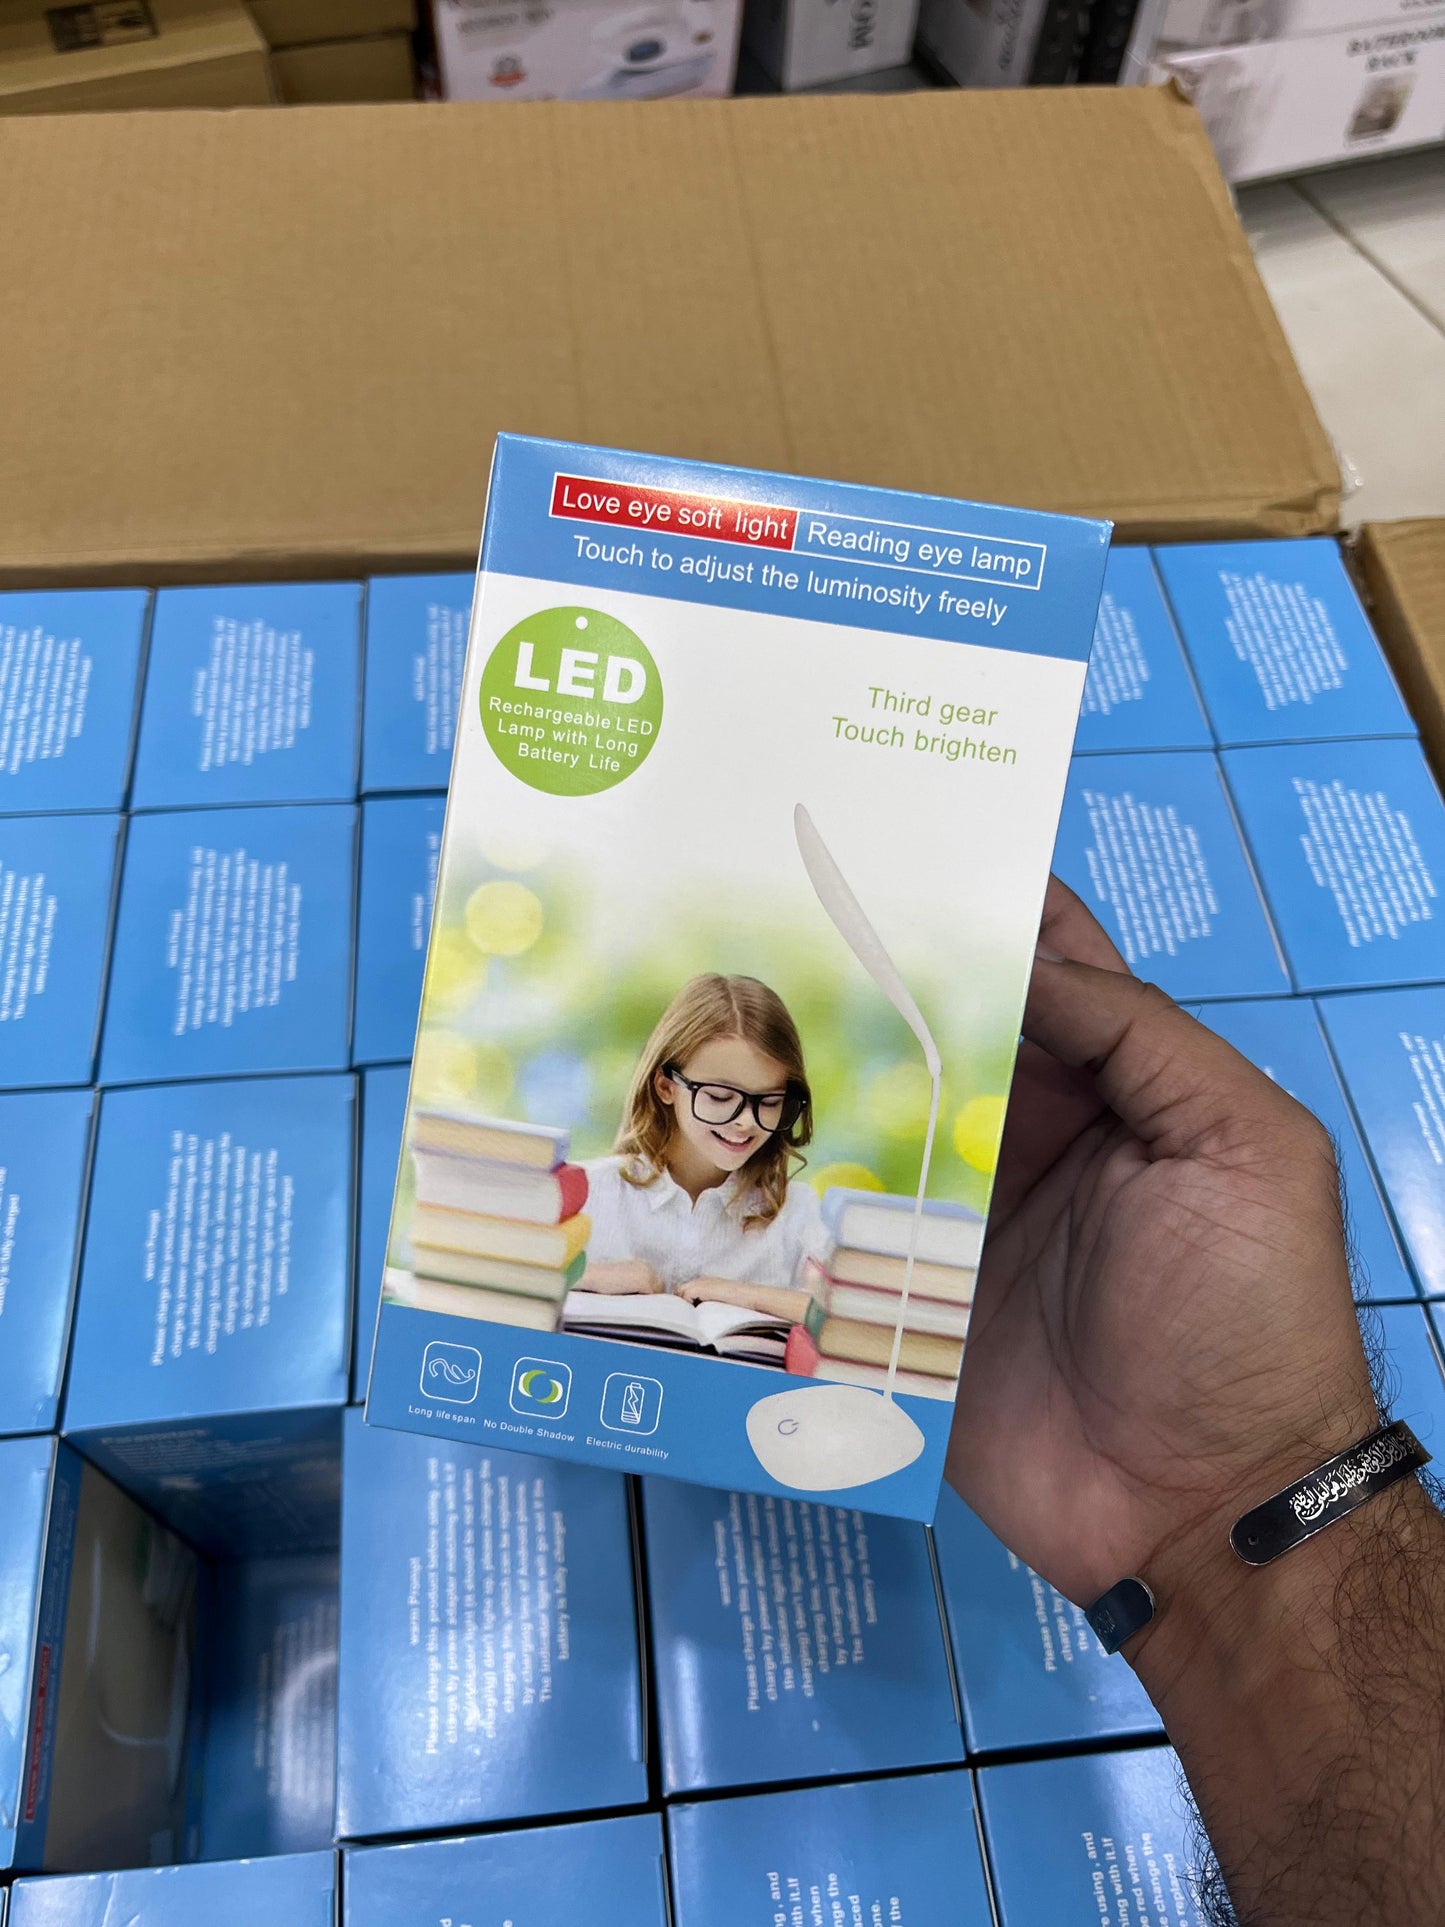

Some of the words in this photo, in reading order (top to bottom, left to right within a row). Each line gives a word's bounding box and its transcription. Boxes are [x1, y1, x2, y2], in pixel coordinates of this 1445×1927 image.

[561, 486, 621, 516] Love
[627, 500, 672, 527] eye
[677, 502, 723, 531] soft
[734, 511, 789, 544] light
[807, 520, 910, 563] Reading
[917, 543, 963, 568] eye
[970, 545, 1031, 580] lamp
[573, 534, 644, 566] Touch
[651, 547, 673, 571] to
[679, 554, 754, 584] adjust
[761, 564, 799, 590] the
[806, 570, 931, 615] luminosity
[938, 590, 1007, 626] freely
[513, 642, 649, 707] LED
[488, 697, 612, 731] Rechargeable
[615, 716, 653, 735] LED
[867, 686, 931, 716] Third
[938, 703, 999, 726] gear
[497, 718, 545, 742] Lamp
[552, 728, 588, 746] with
[594, 733, 638, 757] Long
[517, 741, 580, 768] Battery
[588, 752, 620, 772] Life
[831, 716, 904, 748] Touch
[913, 728, 1017, 765] brighten
[407, 1404, 433, 1418] Long
[483, 1418, 497, 1429] No
[499, 1421, 534, 1435] Double
[536, 1427, 575, 1442] Shadow
[585, 1435, 622, 1450] Electric
[624, 1443, 669, 1460] durability
[1031, 1579, 1047, 1623] charge
[1041, 1626, 1056, 1670] Please
[1057, 1616, 1073, 1661] charge
[1078, 1630, 1088, 1650] the
[747, 1664, 759, 1710] Please
[764, 1654, 777, 1700] charge
[1082, 1832, 1096, 1858] and
[1125, 1844, 1139, 1883] when
[767, 1872, 780, 1899] and
[827, 1873, 838, 1896] the
[1092, 1871, 1107, 1912] using
[1108, 1864, 1122, 1894] with
[1131, 1887, 1145, 1910] red
[1146, 1858, 1165, 1911] change
[1162, 1852, 1184, 1915] replaced
[791, 1905, 802, 1927] ith
[810, 1886, 822, 1925] when
[889, 1897, 900, 1920] the
